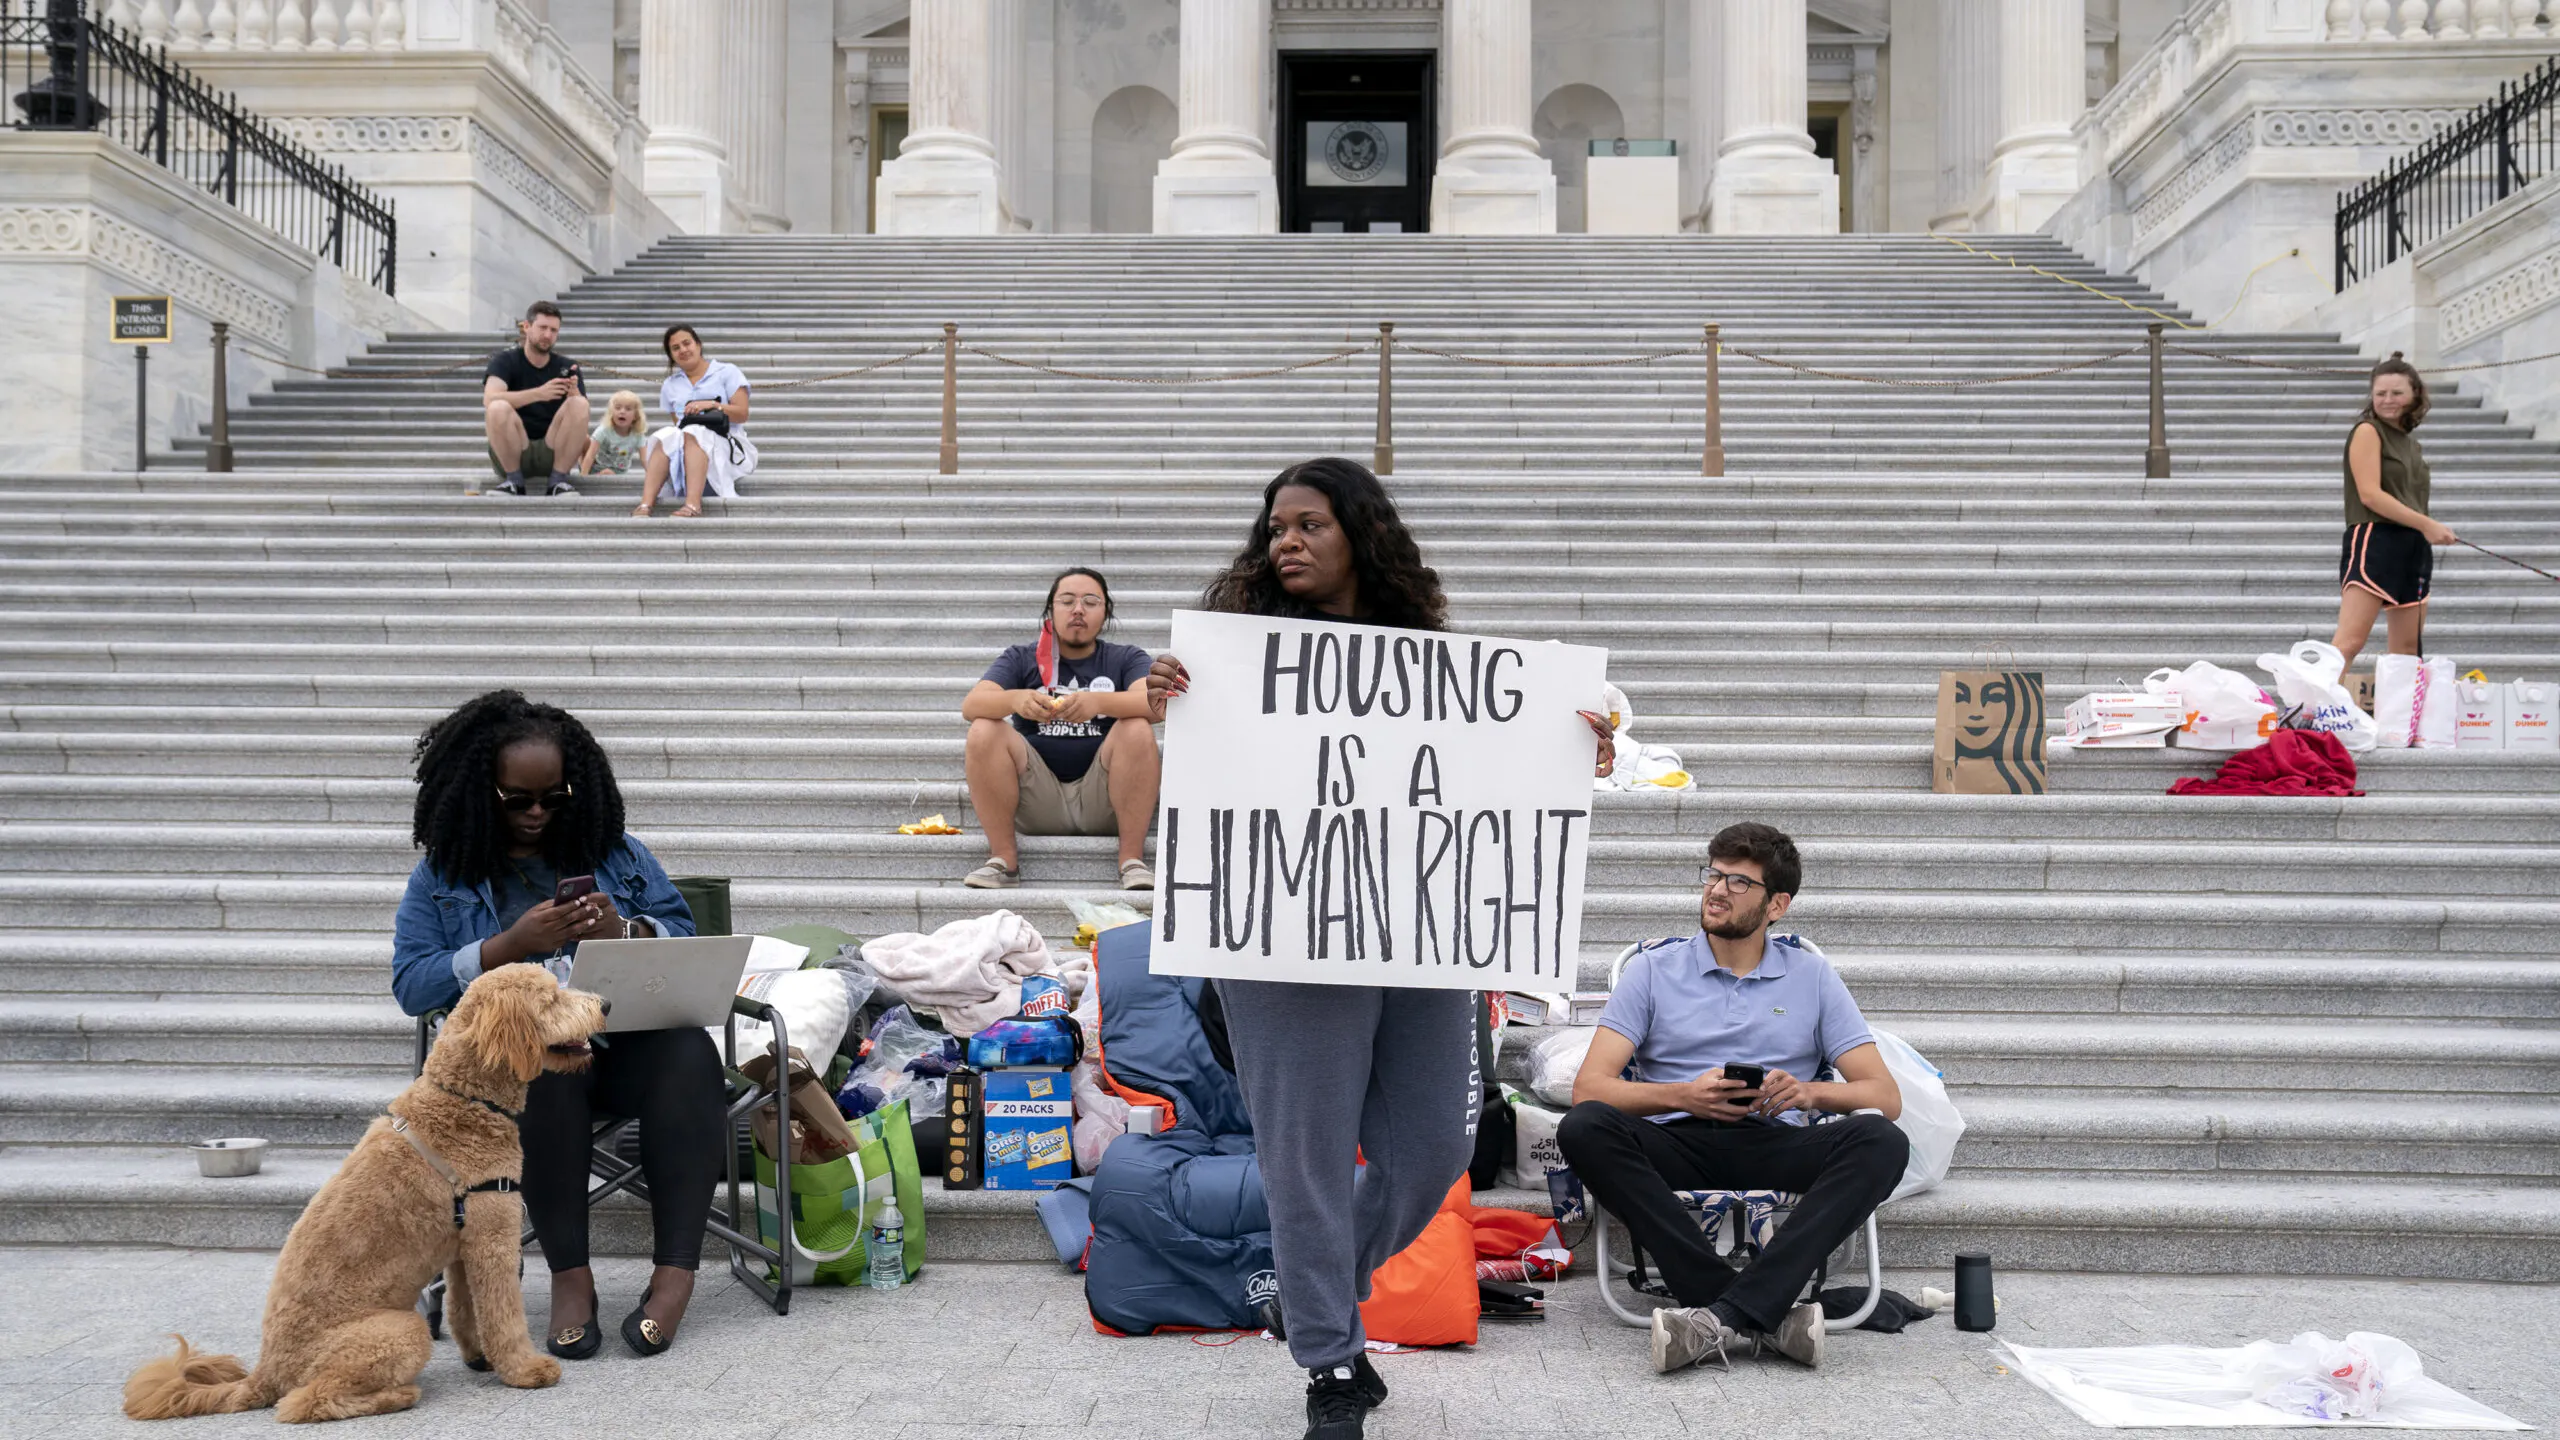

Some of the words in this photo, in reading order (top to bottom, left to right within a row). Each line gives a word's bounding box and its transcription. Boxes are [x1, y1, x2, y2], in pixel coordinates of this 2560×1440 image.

[131, 303, 153, 313] THIS
[115, 314, 167, 325] ENTRANCE
[121, 325, 161, 335] CLOSED
[1262, 632, 1524, 724] HOUSING
[1037, 724, 1085, 736] PEOPLE
[1318, 734, 1366, 808] IS
[1408, 744, 1443, 808] A
[1163, 807, 1393, 963] HUMAN
[1415, 808, 1588, 978] RIGHT
[1465, 1013, 1480, 1136] TROUBLE
[1003, 1104, 1017, 1114] 20
[1020, 1104, 1054, 1114] PACKS
[988, 1134, 1022, 1153] OREO
[998, 1144, 1020, 1157] mini
[1029, 1134, 1065, 1153] OREO
[1248, 1274, 1278, 1296] Cole
